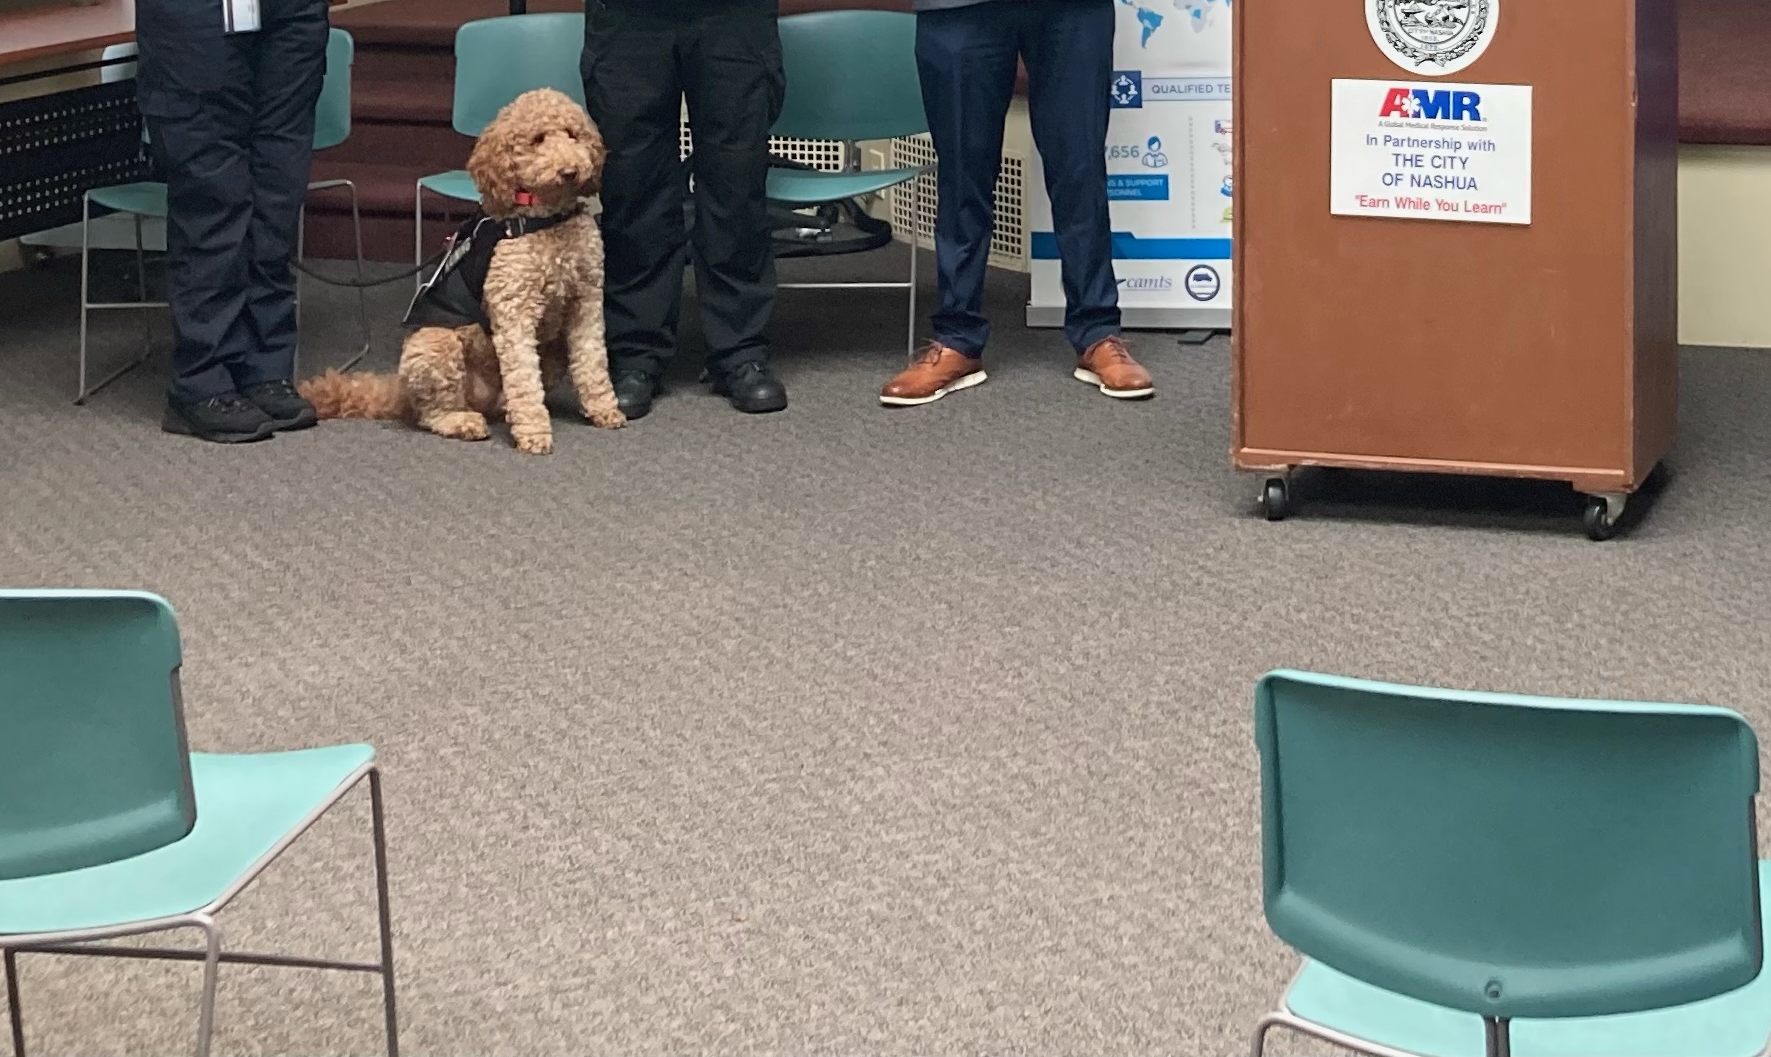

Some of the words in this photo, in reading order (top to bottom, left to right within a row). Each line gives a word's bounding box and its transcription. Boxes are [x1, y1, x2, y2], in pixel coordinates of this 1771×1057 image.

[1152, 84, 1214, 94] QUALIFIED
[1217, 83, 1231, 93] TE
[1379, 88, 1482, 121] AMR
[1431, 123, 1459, 131] Response
[1461, 124, 1488, 132] Solution
[1366, 134, 1378, 147] In
[1383, 135, 1462, 153] Partnership
[1467, 137, 1496, 152] with
[1392, 153, 1424, 168] THE
[1431, 154, 1469, 170] CITY
[1382, 172, 1404, 187] OF
[1410, 173, 1478, 191] NASHUA
[1355, 195, 1390, 210] "Earn
[1395, 197, 1431, 211] While
[1436, 199, 1460, 213] You
[1464, 200, 1507, 215] Learn"
